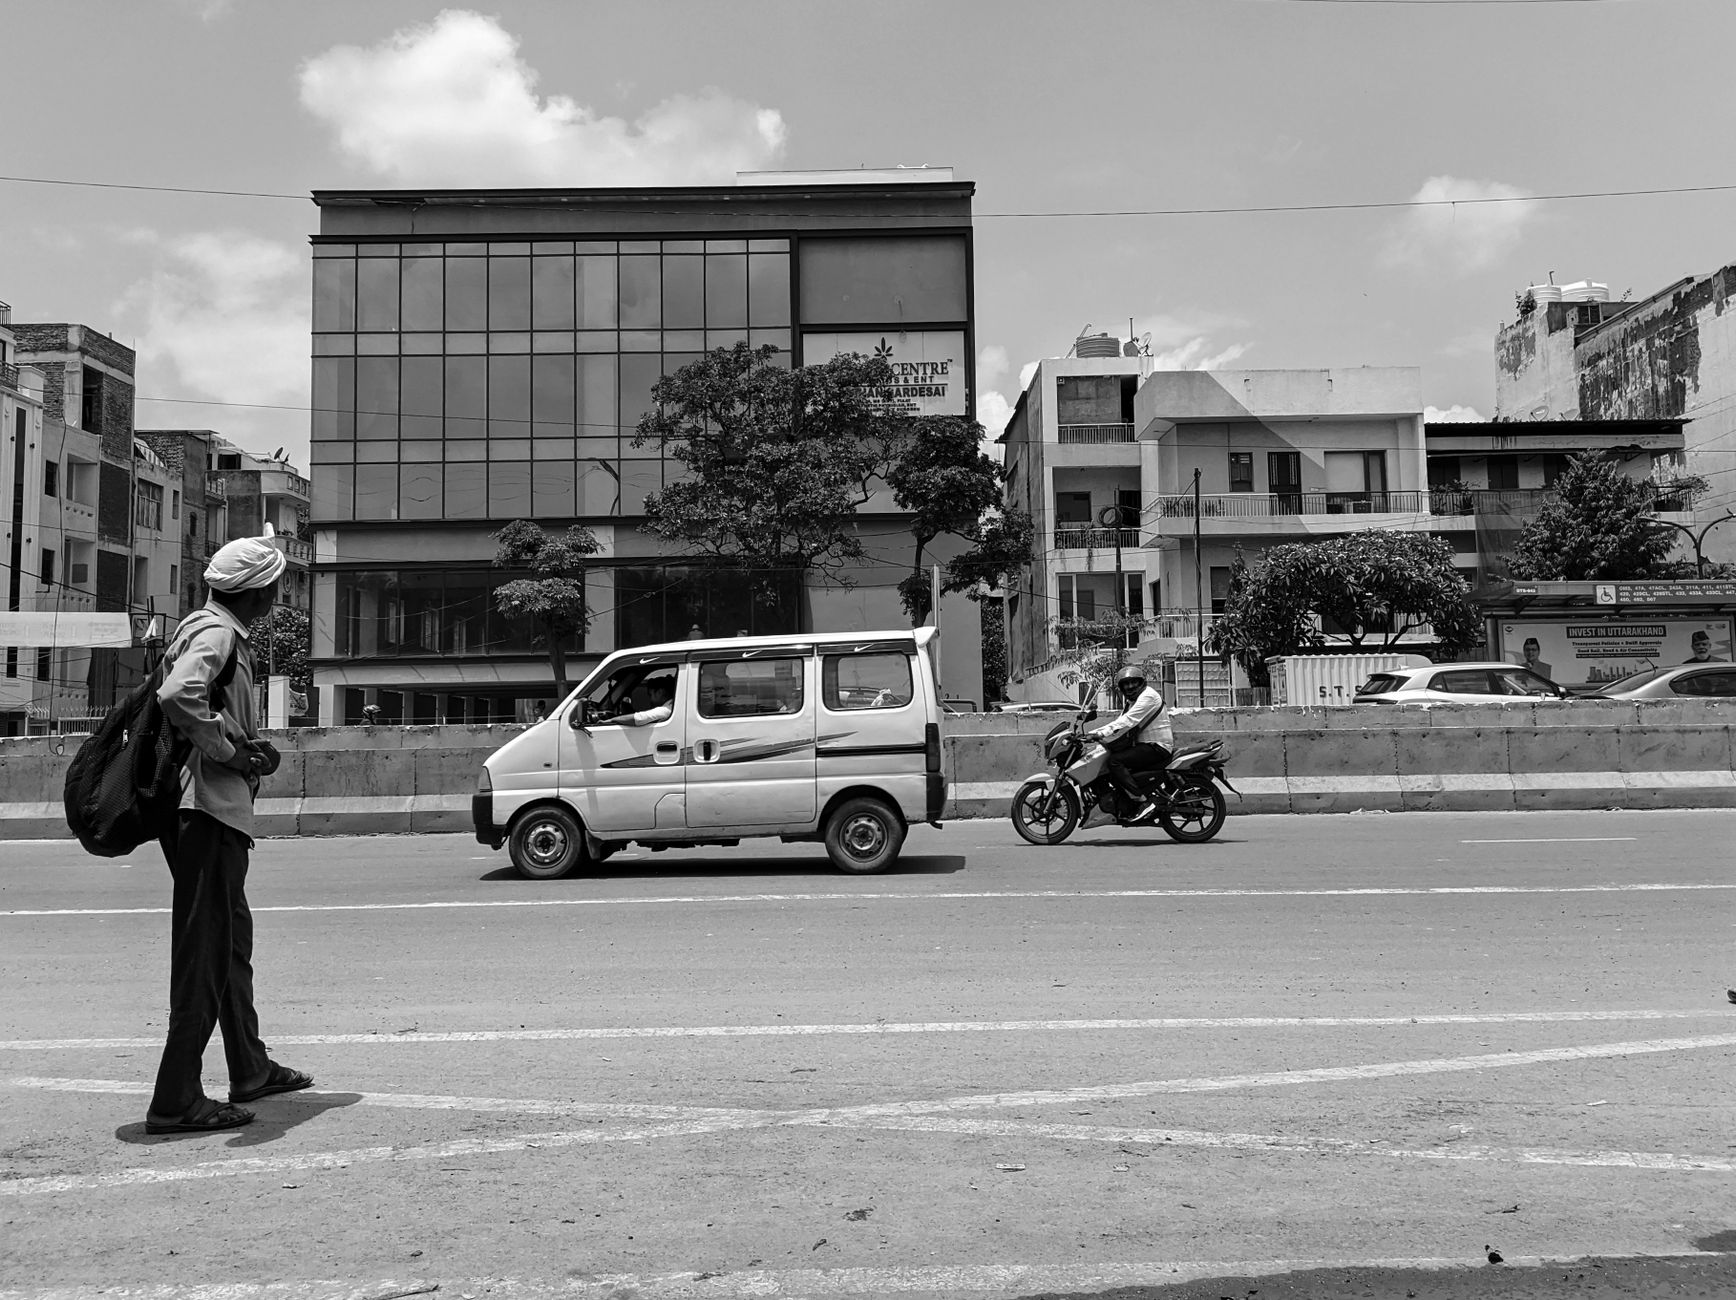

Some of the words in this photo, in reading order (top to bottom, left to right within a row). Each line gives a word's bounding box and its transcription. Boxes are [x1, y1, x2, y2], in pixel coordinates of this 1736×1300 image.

[891, 362, 949, 376] CENTRE
[903, 376, 910, 384] &
[1569, 627, 1596, 637] INVEST
[1597, 627, 1606, 636] IN
[1607, 626, 1664, 636] UTTARAKHAND
